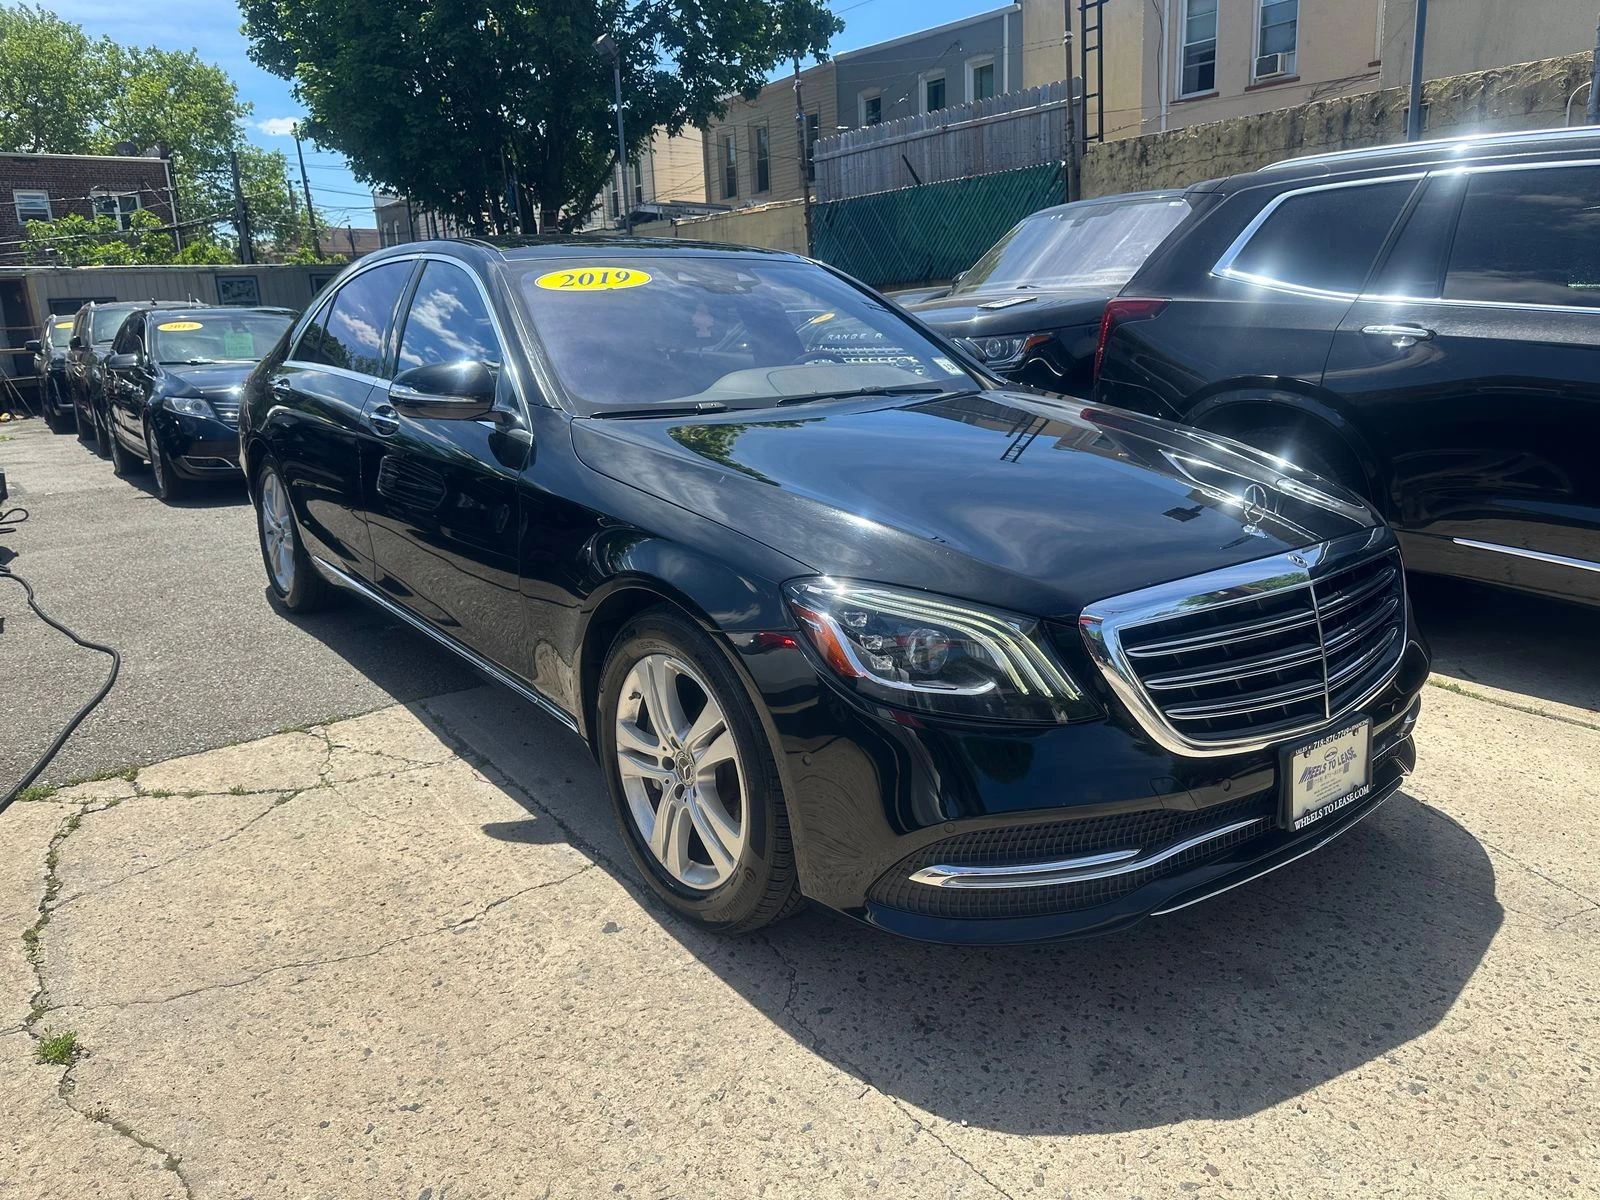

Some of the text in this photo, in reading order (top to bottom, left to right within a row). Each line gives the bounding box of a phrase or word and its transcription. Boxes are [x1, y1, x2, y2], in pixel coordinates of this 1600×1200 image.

[559, 270, 631, 288] 2019
[827, 332, 868, 341] RANGE
[1329, 758, 1337, 771] TO
[1337, 746, 1358, 766] LEASE
[1294, 809, 1323, 831] WHEELS
[1323, 803, 1334, 816] TO
[1334, 784, 1370, 811] LEASE.COM
